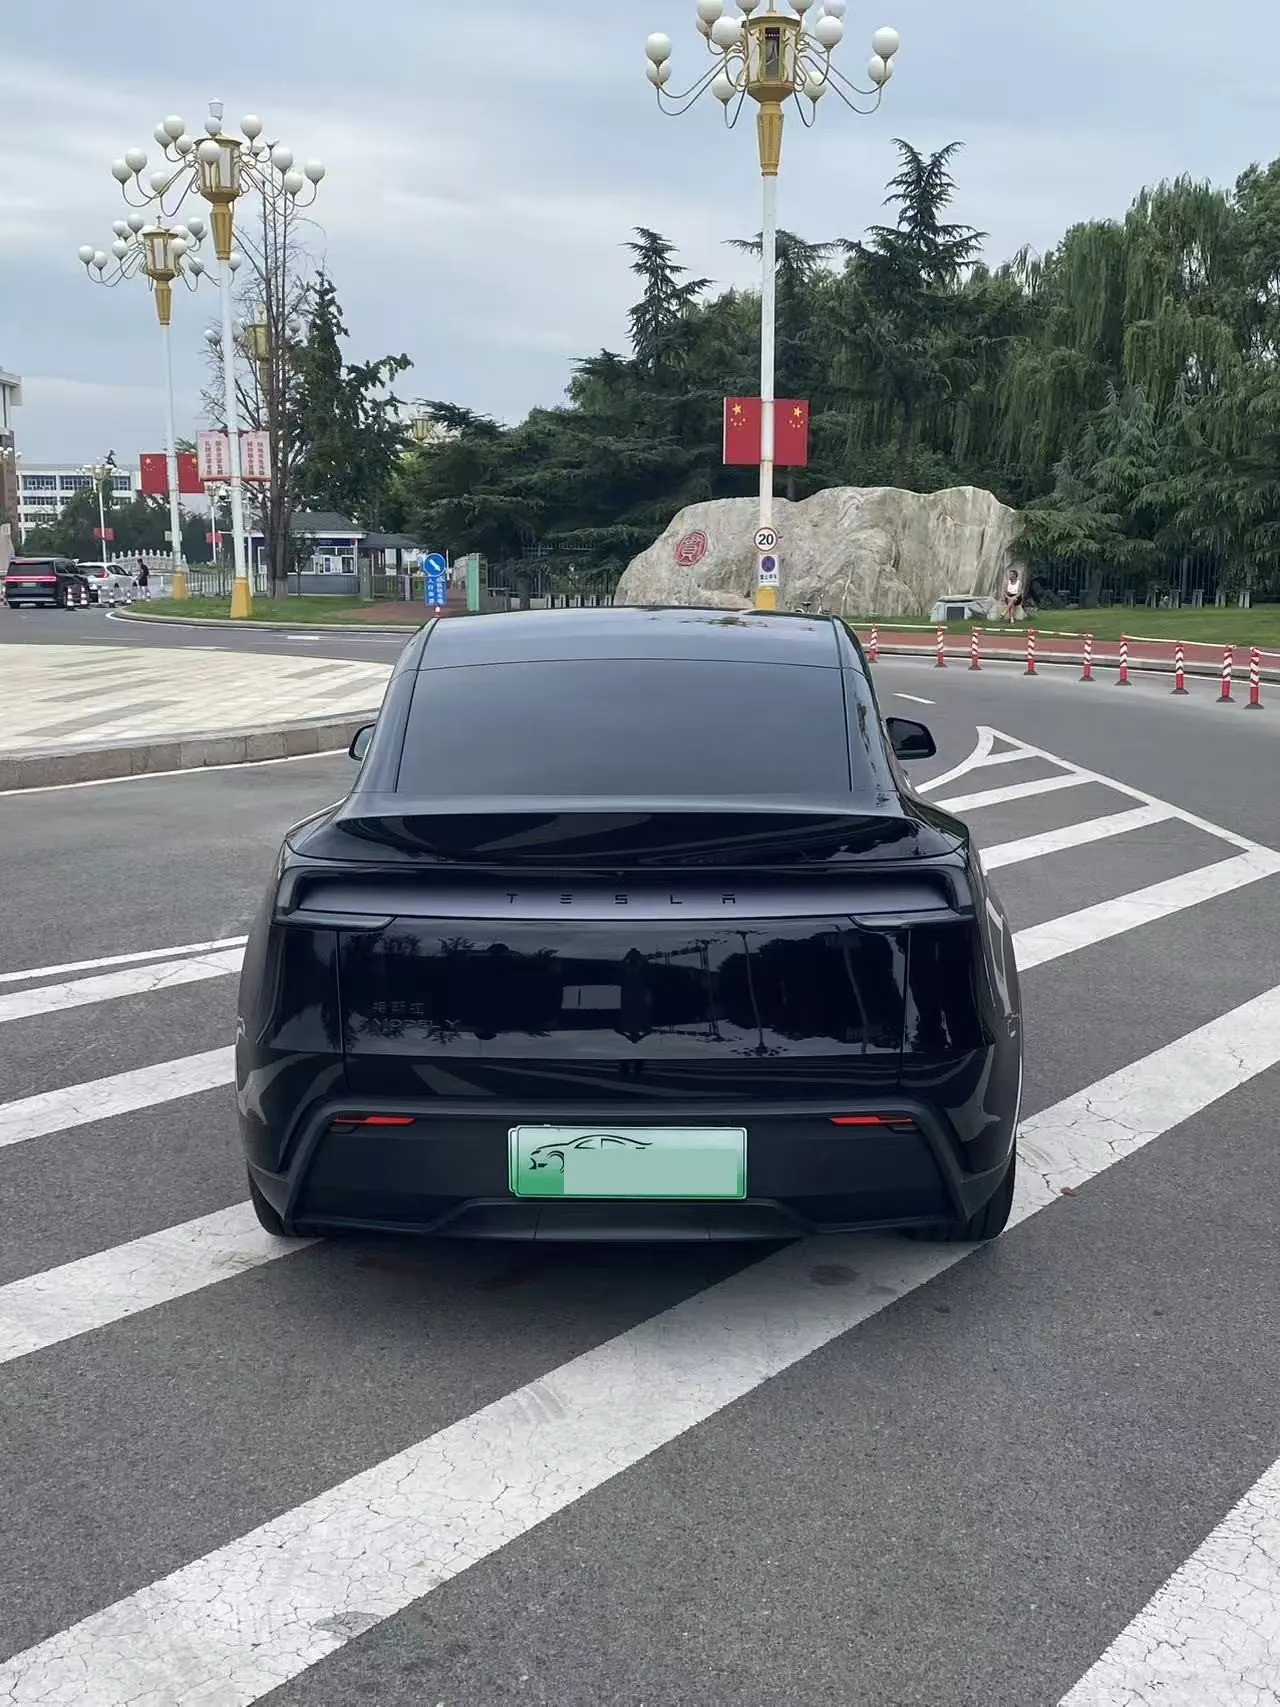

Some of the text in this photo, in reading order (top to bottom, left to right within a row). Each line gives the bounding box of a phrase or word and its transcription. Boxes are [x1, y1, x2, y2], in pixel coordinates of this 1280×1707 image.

[758, 533, 774, 545] 20
[506, 892, 736, 905] TESLA
[372, 1018, 460, 1029] MODEL Y
